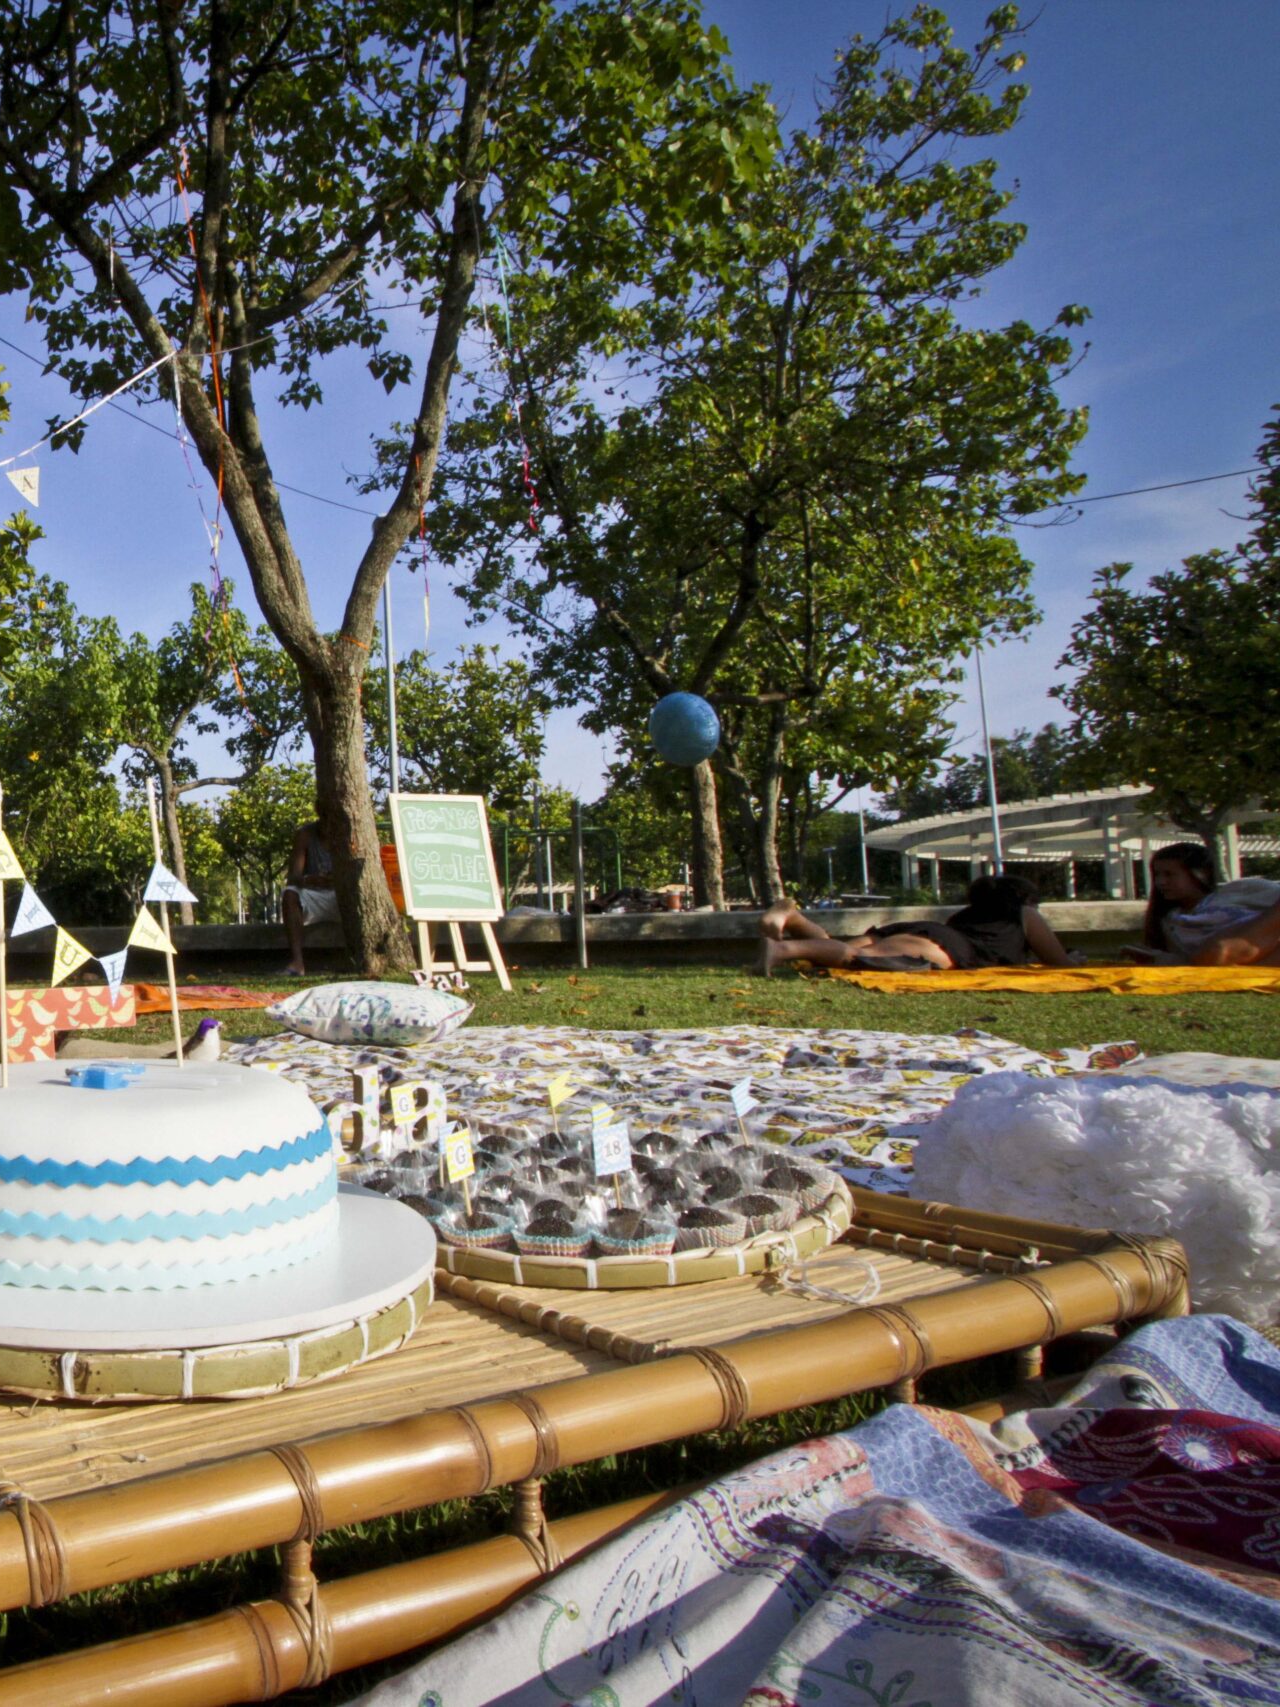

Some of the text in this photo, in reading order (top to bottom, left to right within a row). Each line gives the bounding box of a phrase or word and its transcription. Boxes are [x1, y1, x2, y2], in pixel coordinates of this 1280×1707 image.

[398, 1096, 410, 1113] G
[455, 1145, 466, 1165] G
[603, 1144, 622, 1157] 18
